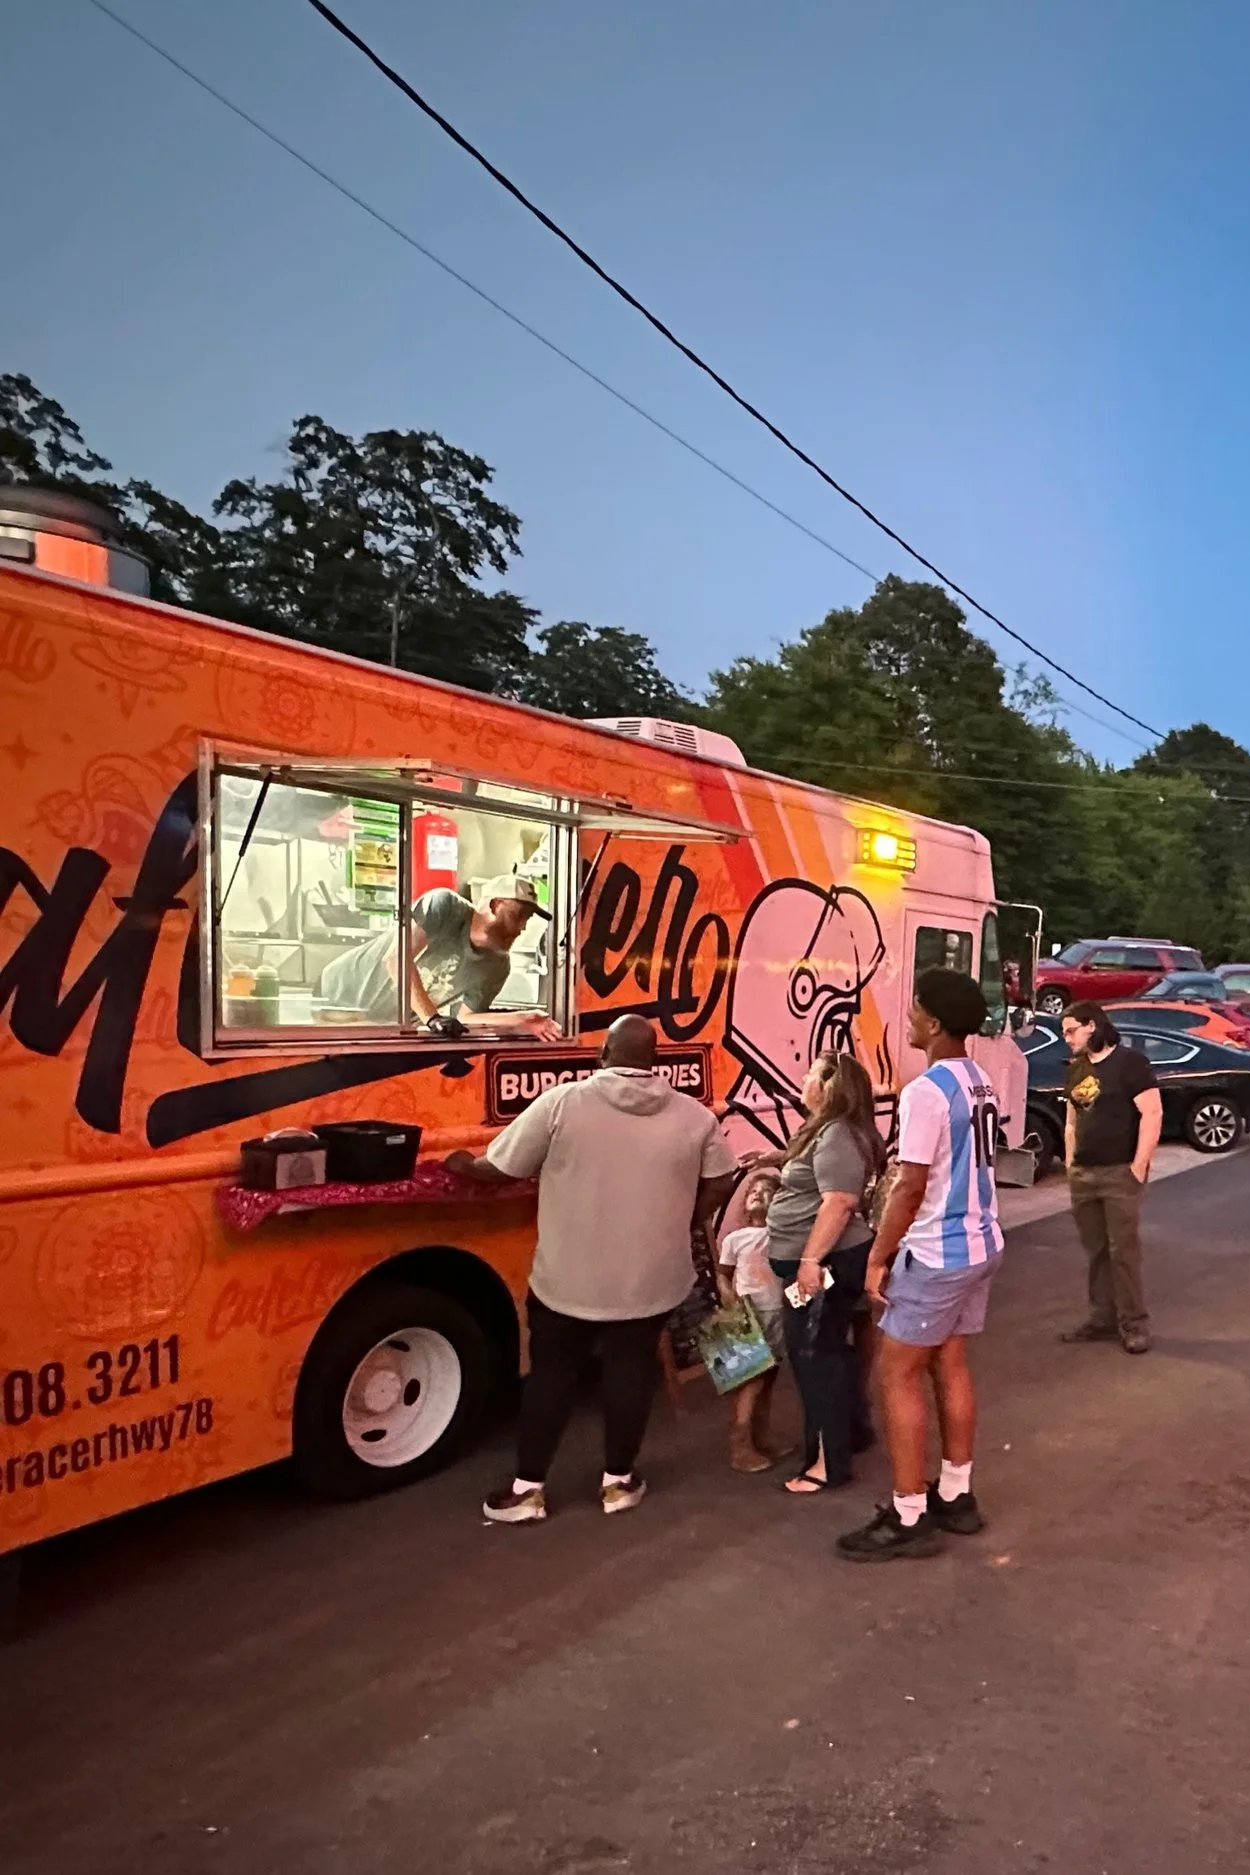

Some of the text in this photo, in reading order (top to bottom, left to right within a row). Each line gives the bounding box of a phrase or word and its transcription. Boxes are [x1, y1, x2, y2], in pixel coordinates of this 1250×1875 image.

[651, 1063, 701, 1088] RIES
[971, 1103, 998, 1168] 10
[3, 1333, 179, 1427] 08.3211
[0, 1397, 214, 1494] racerhwy78
